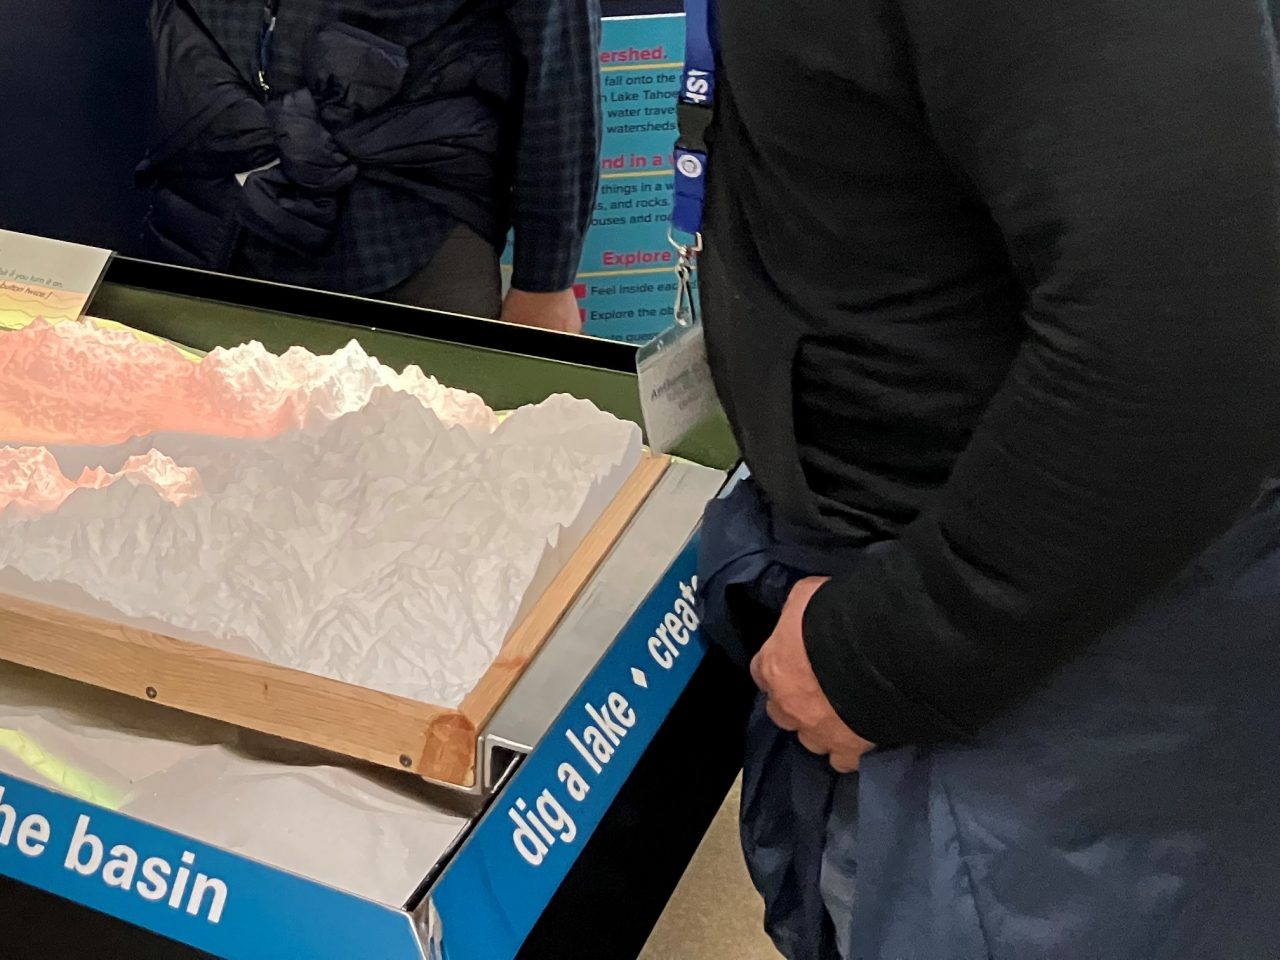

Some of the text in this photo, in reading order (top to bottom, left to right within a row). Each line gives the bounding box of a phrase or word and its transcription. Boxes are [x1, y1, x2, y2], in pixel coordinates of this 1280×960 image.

[626, 75, 653, 86] onto
[657, 73, 676, 84] the
[611, 91, 639, 102] Lake
[607, 107, 641, 119] water
[631, 154, 647, 168] in
[653, 156, 663, 167] a
[601, 182, 662, 196] things in a
[610, 197, 670, 210] and rocks.
[629, 214, 651, 224] and
[602, 249, 672, 267] Explore
[591, 285, 616, 296] Feel
[619, 283, 655, 295] inside
[590, 310, 634, 322] Explore
[637, 307, 657, 318] the
[565, 692, 636, 775] lake
[557, 763, 590, 800] a
[508, 788, 576, 866] dig
[64, 815, 227, 923] basin
